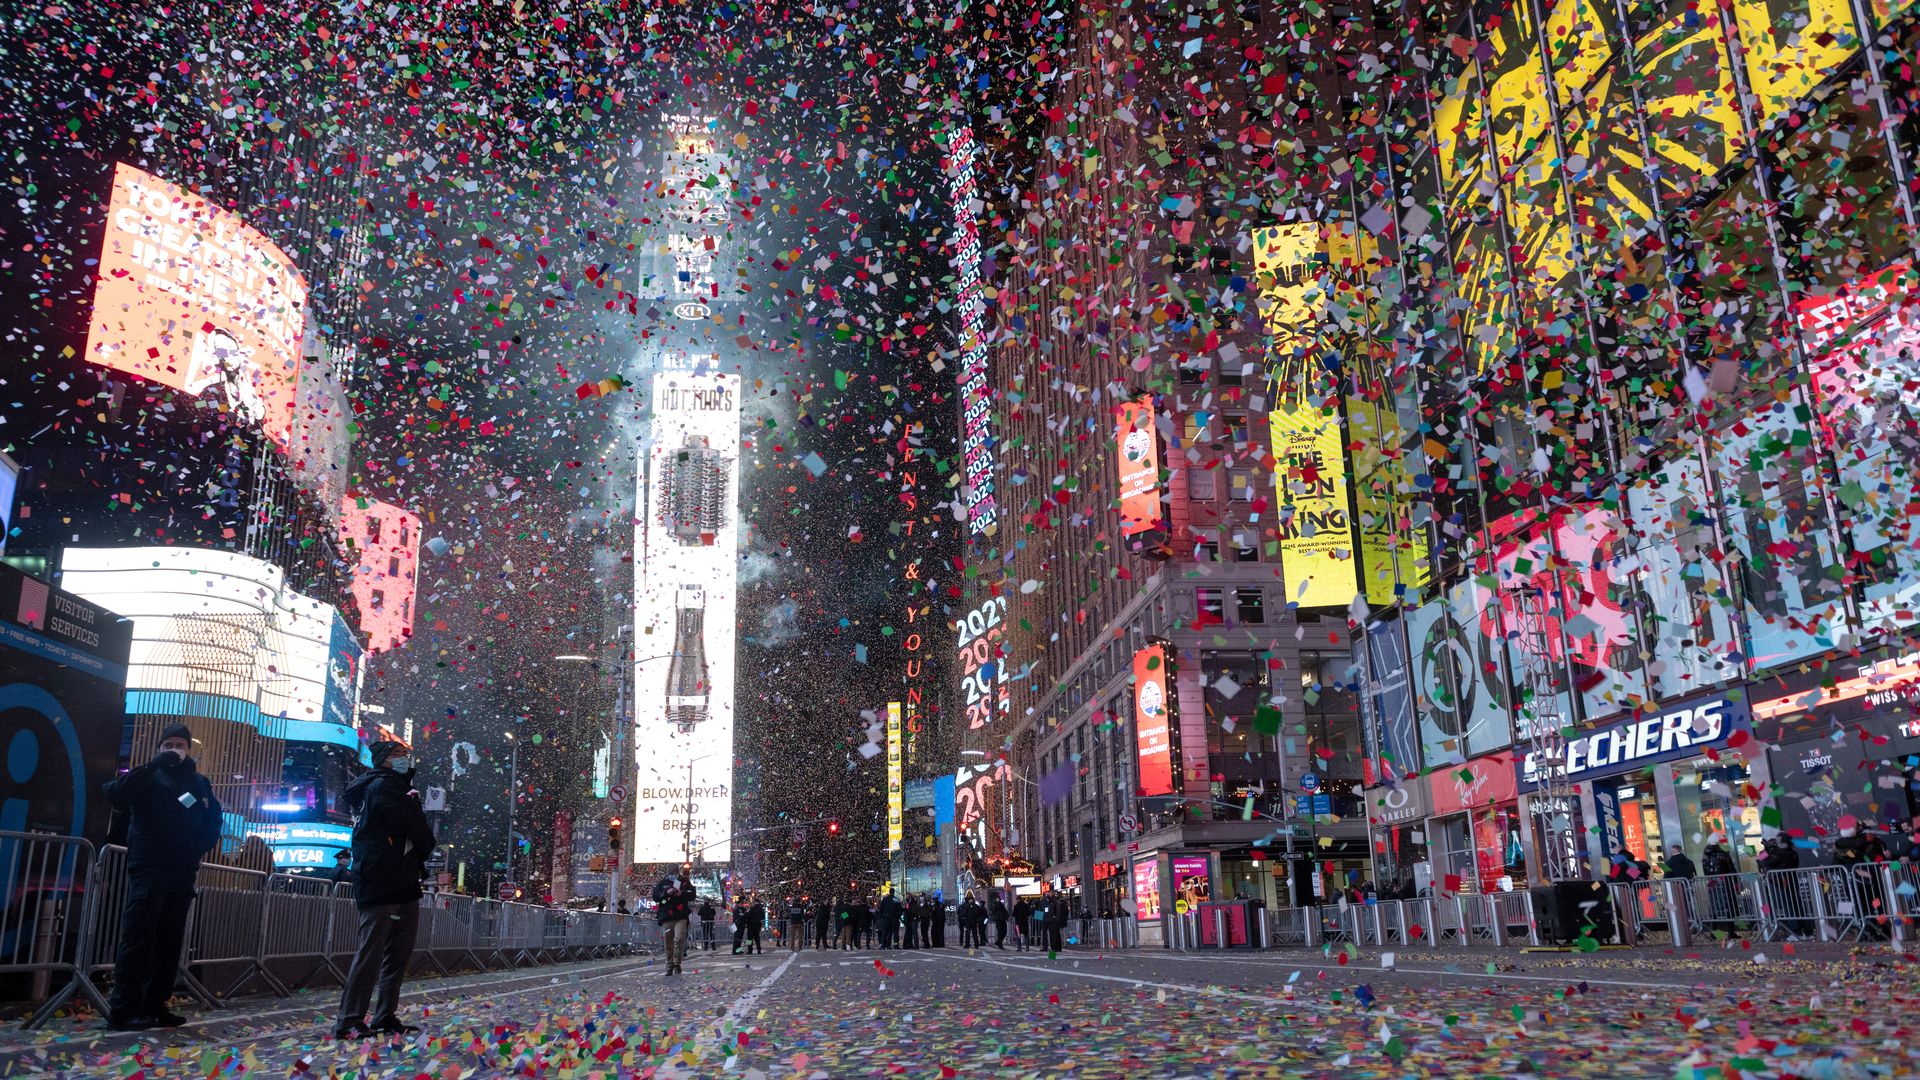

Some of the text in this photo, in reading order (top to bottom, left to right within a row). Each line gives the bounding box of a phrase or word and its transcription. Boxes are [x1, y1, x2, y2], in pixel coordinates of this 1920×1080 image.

[950, 166, 975, 192] 2021
[955, 228, 980, 254] 2021
[957, 239, 981, 266] 2021
[132, 240, 168, 274] IN
[175, 256, 231, 301] THE
[961, 342, 987, 370] 2021
[661, 389, 690, 410] HOT
[965, 395, 991, 424] 2021
[967, 450, 994, 479] 2021
[1288, 451, 1324, 468] THE
[1121, 467, 1155, 482] ENTRANCE
[1282, 474, 1335, 502] LON
[969, 507, 997, 535] 2021
[1297, 540, 1350, 548] AWARD-WINNING
[905, 563, 918, 579] &
[55, 595, 95, 624] VISITOR
[50, 616, 100, 648] SERVICES
[957, 596, 1007, 647] 2021
[10, 630, 25, 641] FREE
[907, 607, 922, 733] YOUNG
[1140, 725, 1167, 738] ENTRANCE
[1149, 737, 1158, 745] ON
[1523, 700, 1723, 783] SKECHERS
[1140, 743, 1168, 757] BROADWAY
[1800, 755, 1832, 769] TISSOT
[642, 787, 728, 799] BLOW DRYER
[671, 803, 699, 814] AND
[663, 820, 706, 830] BRUSH
[289, 849, 324, 862] YEAR
